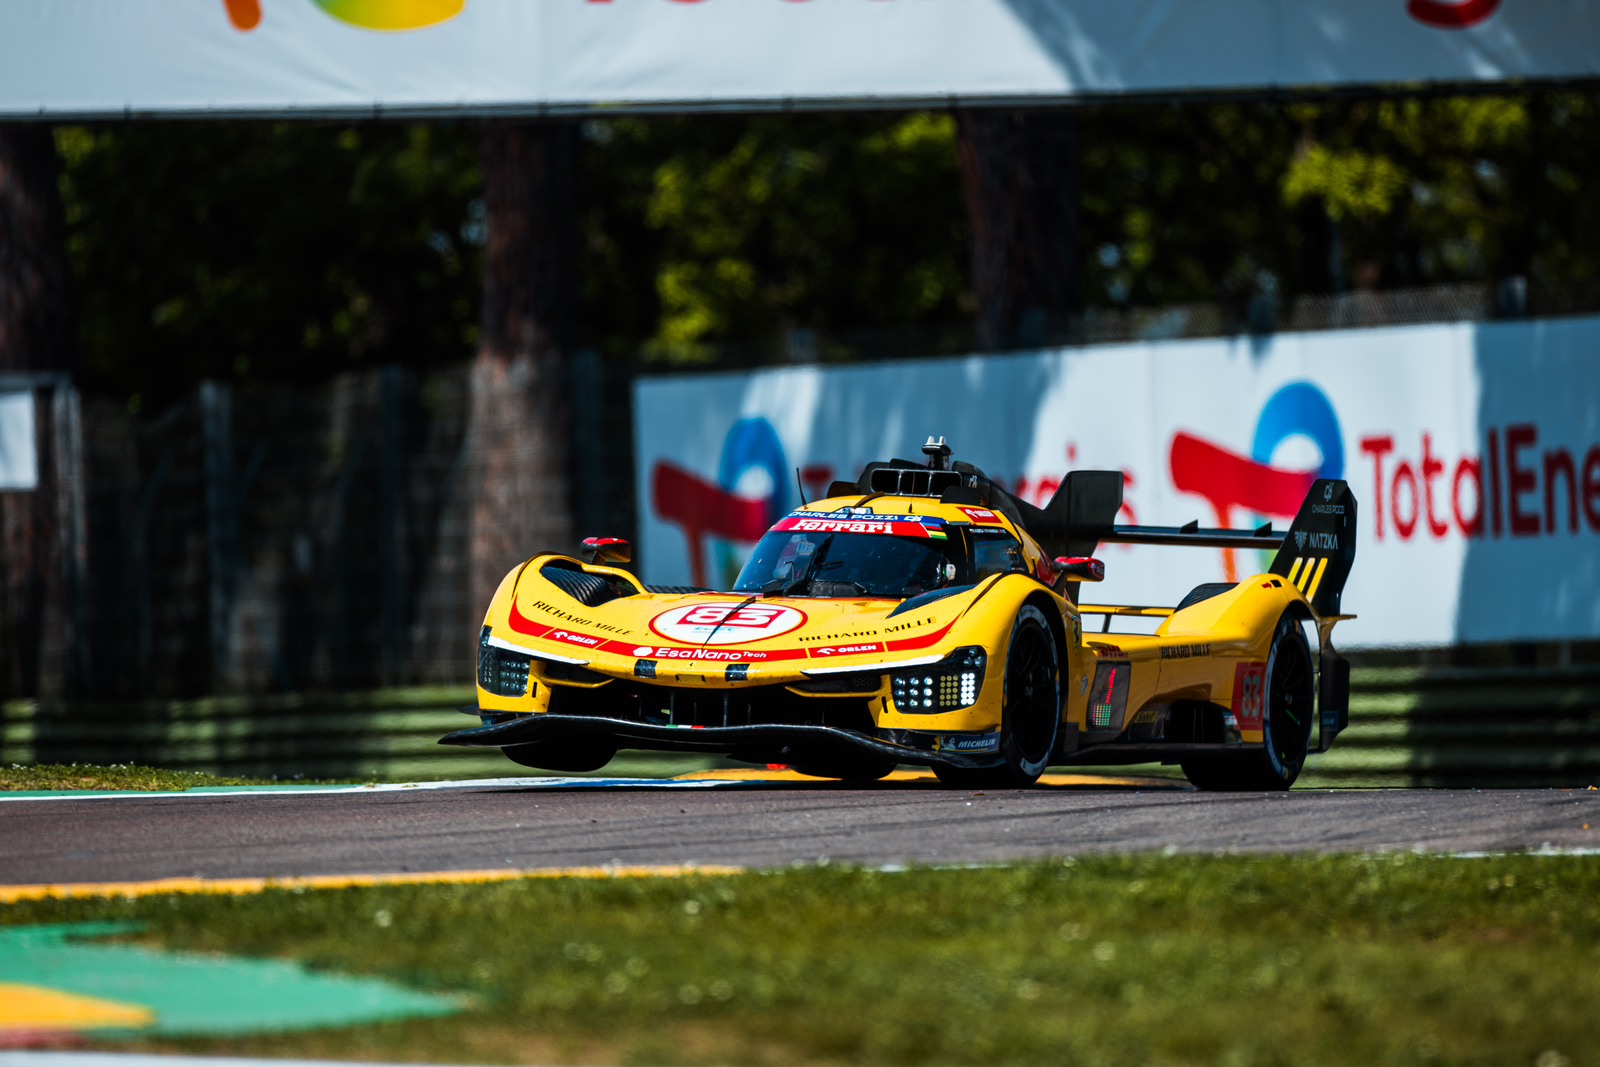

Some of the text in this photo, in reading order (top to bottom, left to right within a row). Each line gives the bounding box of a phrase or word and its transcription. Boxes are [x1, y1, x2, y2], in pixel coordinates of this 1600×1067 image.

[788, 511, 847, 519] CHARLES
[1312, 504, 1344, 515] CHARLES POZZI
[789, 518, 893, 534] Ferrari
[1309, 532, 1338, 550] NATZKA
[533, 600, 634, 636] RICHARD MILLE
[685, 606, 771, 626] 83
[799, 616, 937, 642] RICHARD MILLE
[567, 634, 598, 646] ORLEN
[838, 644, 877, 653] ORLEN
[1160, 643, 1211, 660] RICHARD MILLE
[1242, 675, 1261, 718] 83
[958, 738, 997, 748] MICHELIN
